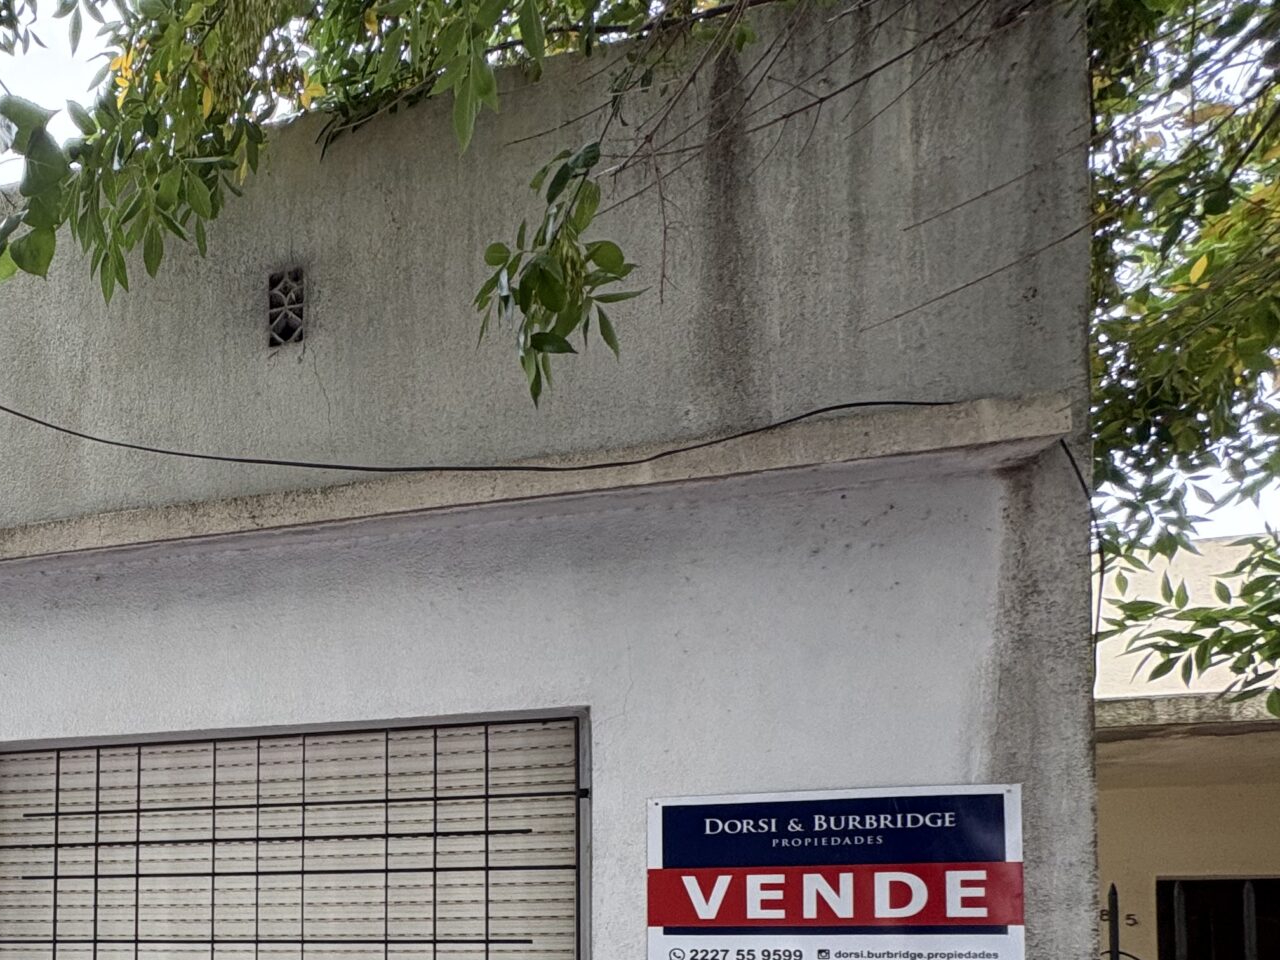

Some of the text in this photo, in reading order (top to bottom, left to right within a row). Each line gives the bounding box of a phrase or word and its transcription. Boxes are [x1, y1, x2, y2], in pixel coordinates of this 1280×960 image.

[704, 812, 956, 835] DORSI & BURBRIDGE
[772, 835, 884, 848] PROPIEDADES
[681, 870, 989, 920] VENDE
[689, 949, 729, 960] 2227
[736, 949, 756, 960] 55
[834, 950, 999, 960] dorsi.burbridge.propiedades
